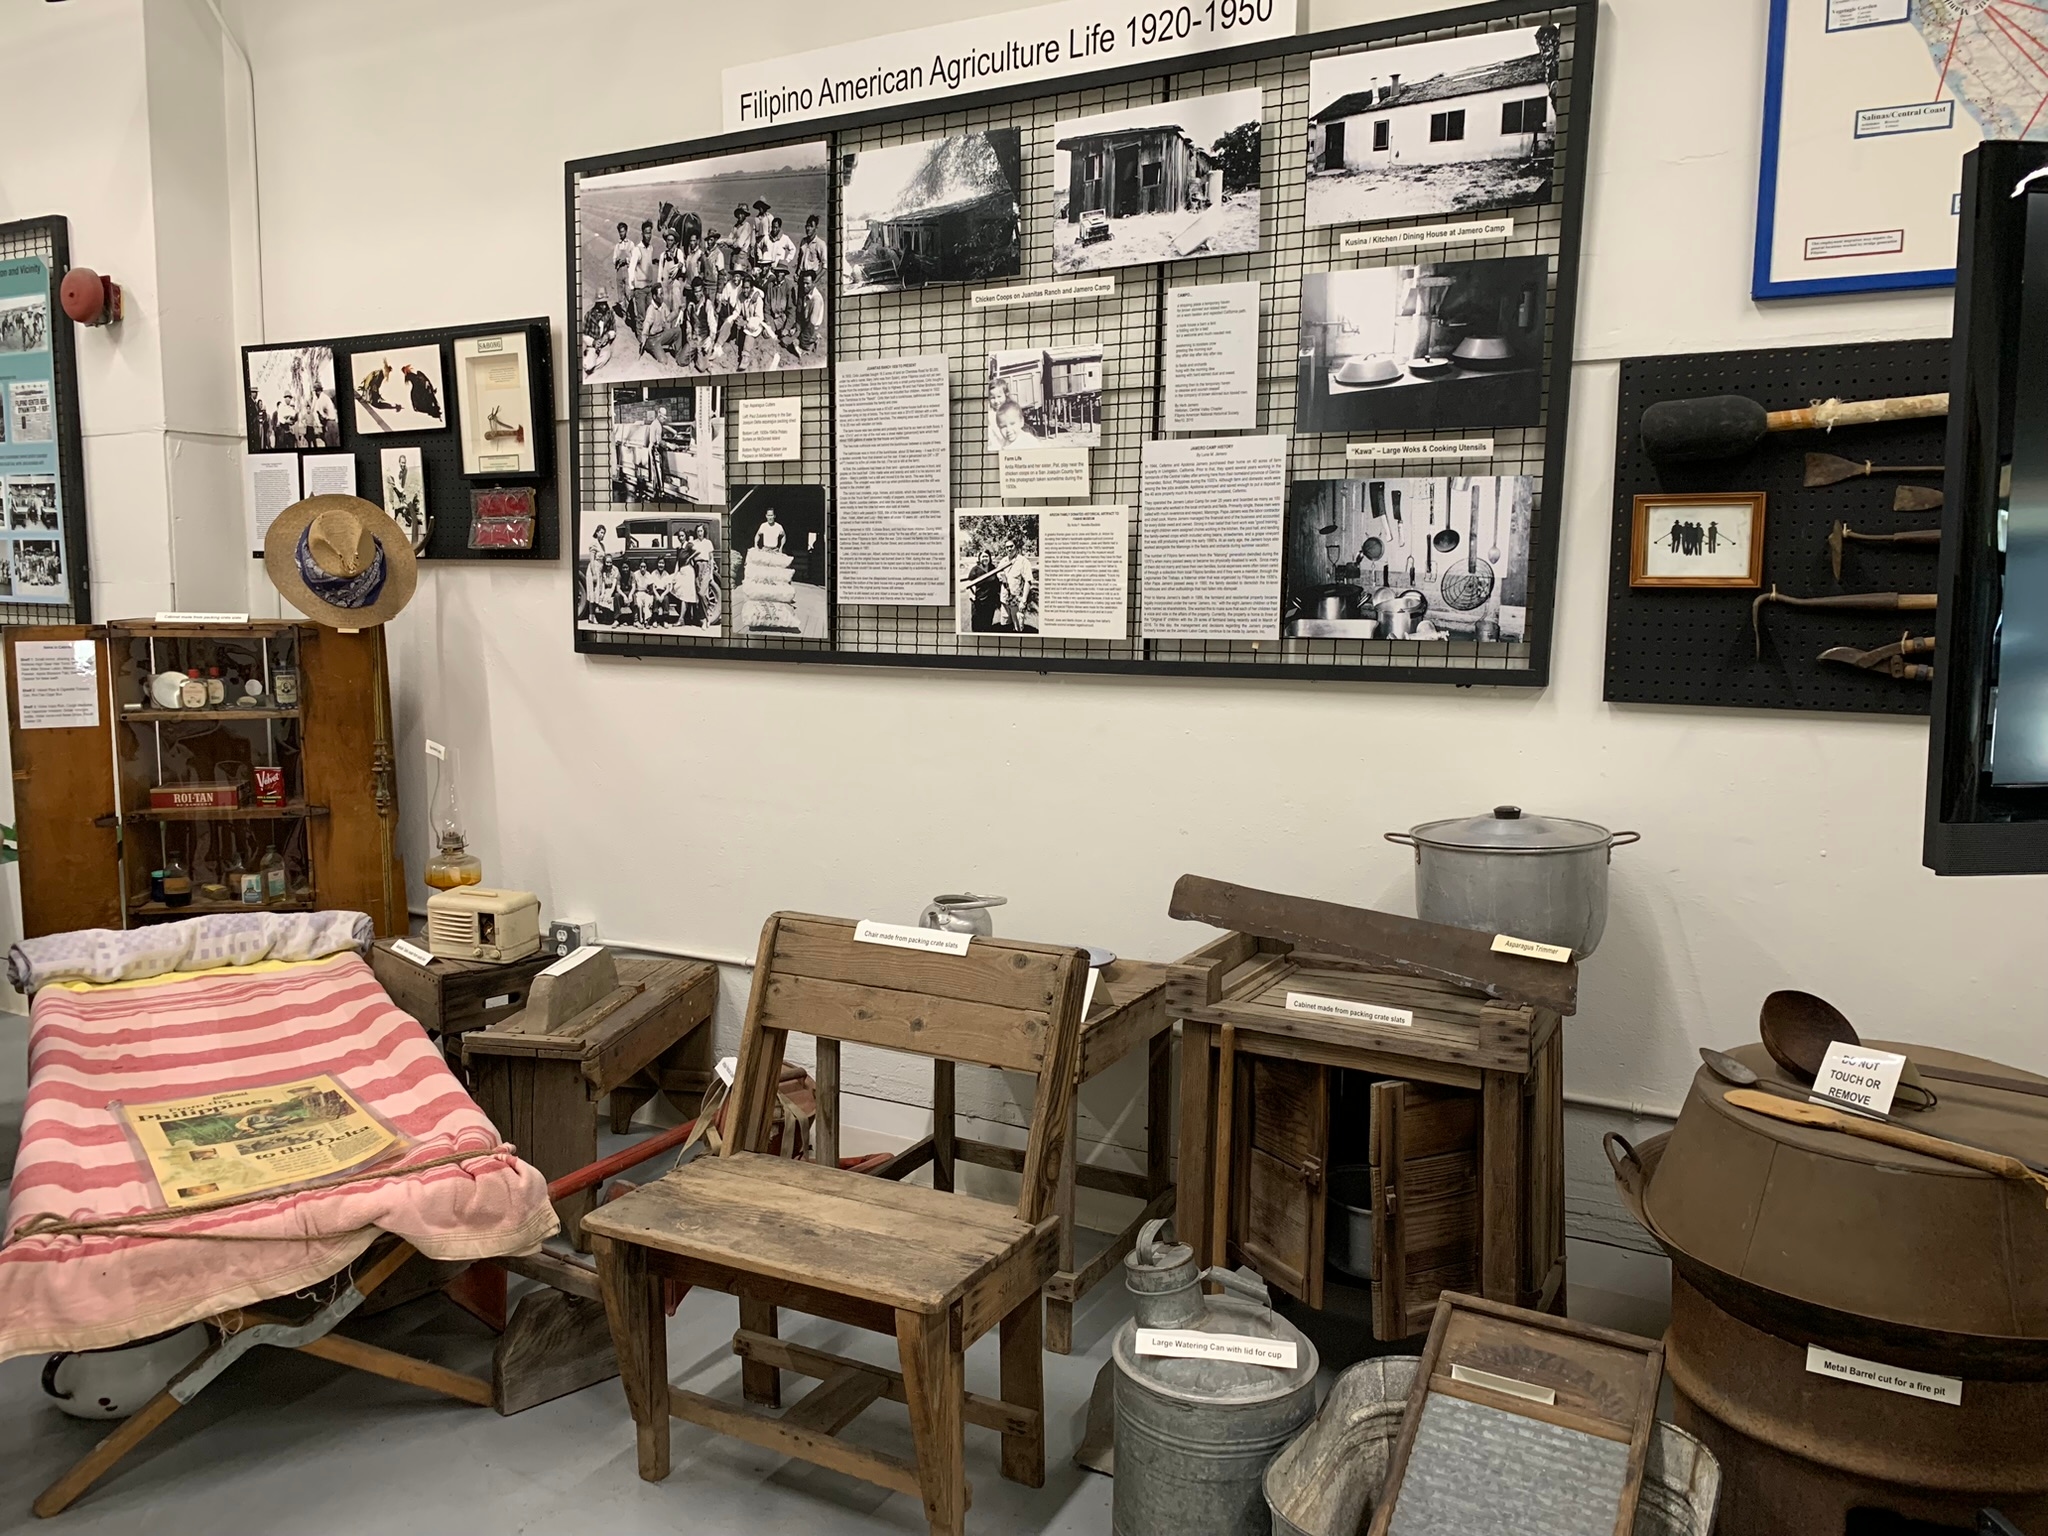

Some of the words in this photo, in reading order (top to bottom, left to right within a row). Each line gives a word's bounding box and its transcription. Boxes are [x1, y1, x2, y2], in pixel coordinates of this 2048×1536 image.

[740, 86, 812, 123] Filipino
[818, 66, 922, 107] American
[929, 40, 1060, 89] Agriculture
[1069, 23, 1115, 59] Life
[1126, 0, 1273, 47] 1920-1950
[1861, 108, 1922, 121] Salinas/Central
[1924, 106, 1946, 115] Coast
[1373, 235, 1397, 244] Kitchen
[1403, 231, 1424, 241] Dining
[1458, 227, 1482, 236] Jamero
[1485, 225, 1505, 233] Camp
[1429, 445, 1457, 453] Cooking
[1459, 444, 1486, 452] Utensils
[256, 771, 279, 790] Velvet
[908, 937, 929, 946] packing
[1505, 940, 1534, 951] Asparagus
[1536, 945, 1558, 954] Trimmer
[1294, 1000, 1316, 1010] Cabinet
[1350, 1009, 1373, 1020] packing
[1858, 1060, 1880, 1071] NOT
[1830, 1069, 1864, 1085] TOUCH
[1865, 1078, 1881, 1089] OR
[1828, 1087, 1871, 1105] REMOVE
[138, 1098, 273, 1122] Philippines
[280, 1144, 313, 1157] the
[316, 1126, 370, 1146] Delta
[1152, 1338, 1173, 1348] Large
[1175, 1340, 1208, 1351] Watering
[1210, 1343, 1224, 1352] Can
[1227, 1345, 1242, 1354] with
[1244, 1347, 1253, 1355] lid
[1255, 1348, 1265, 1357] for
[1268, 1351, 1282, 1359] cup
[1824, 1360, 1847, 1374] Metal
[1850, 1367, 1876, 1380] Barrel
[1878, 1374, 1892, 1384] cut
[1894, 1377, 1907, 1387] for
[1917, 1382, 1931, 1392] fire
[1934, 1386, 1945, 1396] pit
